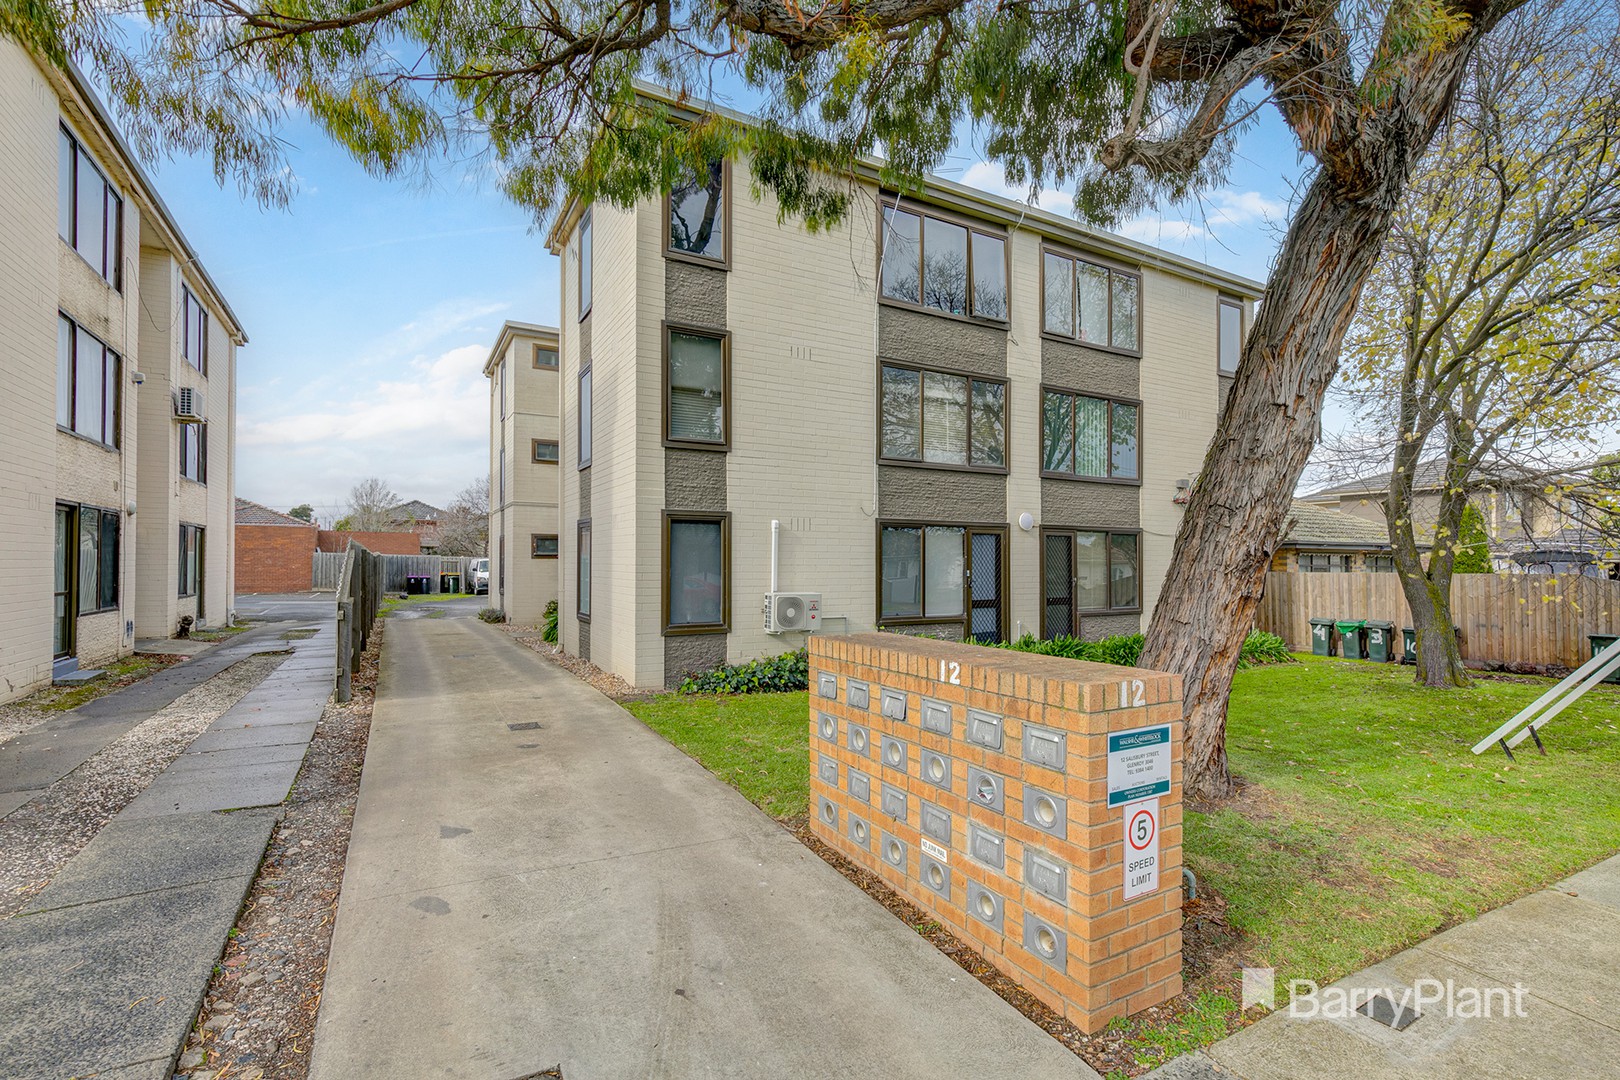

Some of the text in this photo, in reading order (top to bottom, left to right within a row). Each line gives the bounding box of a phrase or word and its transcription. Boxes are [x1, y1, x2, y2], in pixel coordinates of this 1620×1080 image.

[1313, 624, 1326, 641] 4
[940, 659, 961, 685] 12
[1120, 679, 1146, 708] 12
[1126, 753, 1145, 762] SALISBURY
[1127, 760, 1144, 769] GLENROY
[1137, 818, 1147, 841] 5
[1128, 856, 1155, 873] SPEED
[1131, 872, 1152, 888] LIMIT
